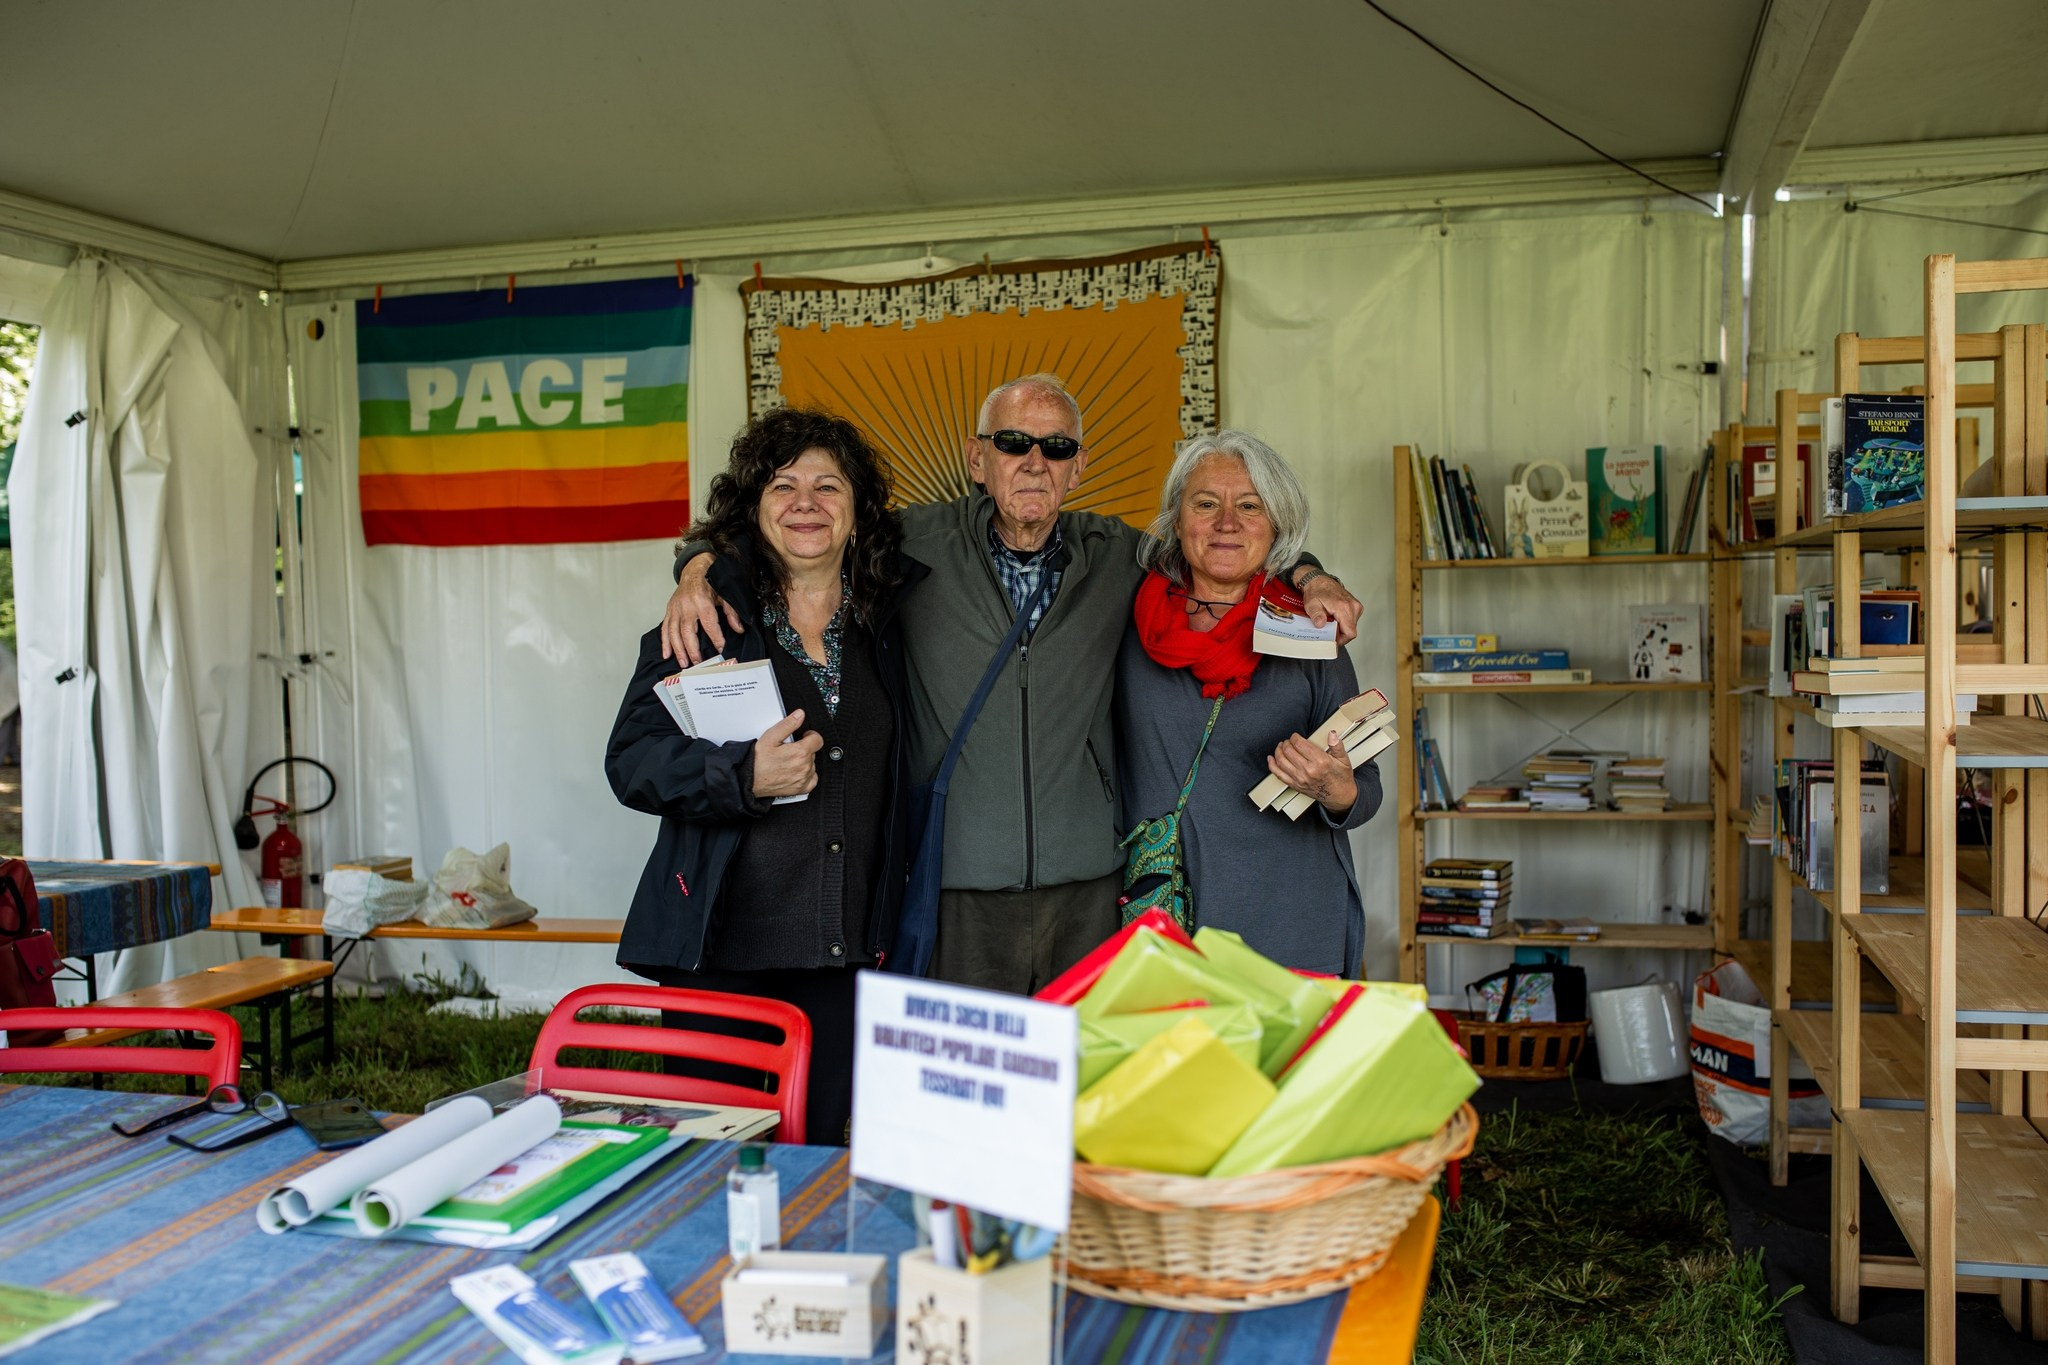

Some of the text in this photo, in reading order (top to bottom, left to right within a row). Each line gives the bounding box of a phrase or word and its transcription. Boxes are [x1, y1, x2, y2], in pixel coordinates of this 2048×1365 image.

[407, 357, 628, 432] PACE
[1858, 410, 1919, 419] STEFANO BENNI
[1539, 516, 1568, 526] PETER
